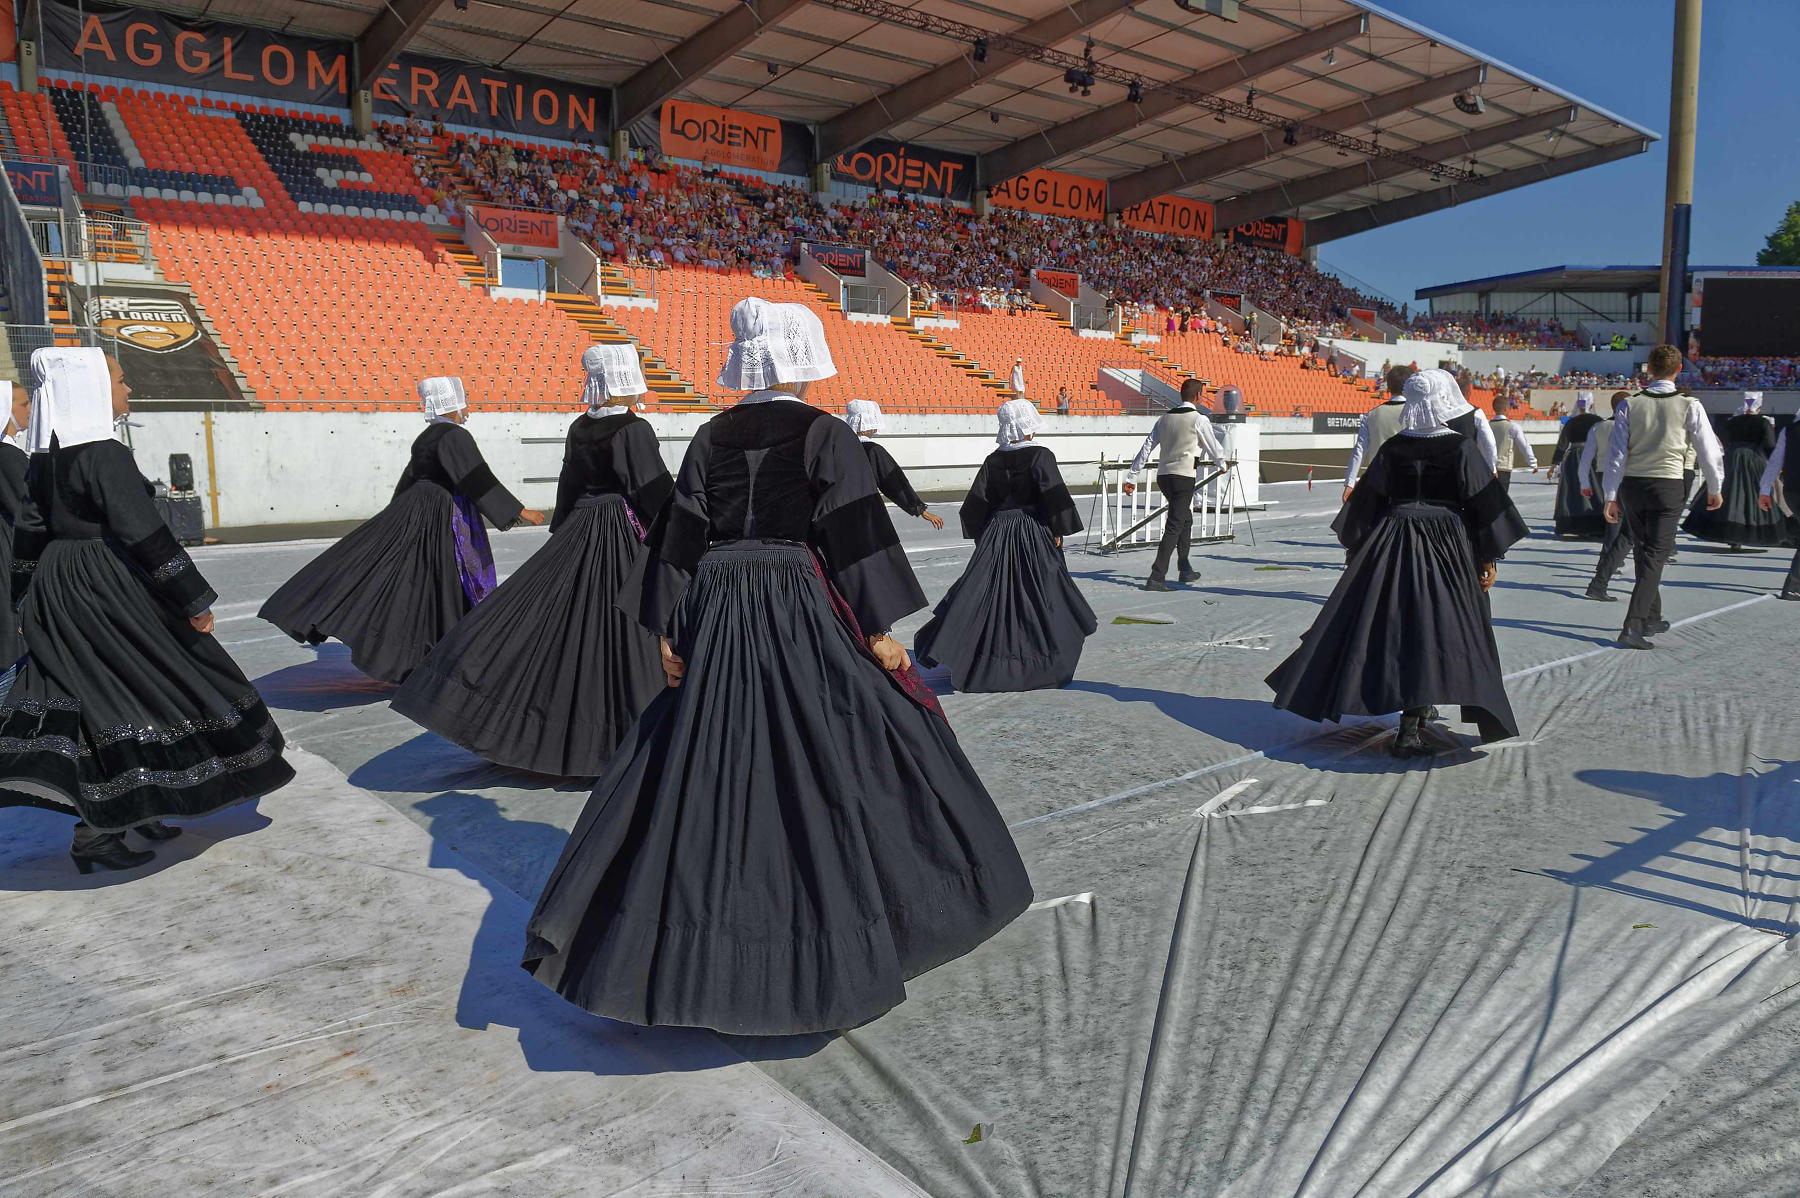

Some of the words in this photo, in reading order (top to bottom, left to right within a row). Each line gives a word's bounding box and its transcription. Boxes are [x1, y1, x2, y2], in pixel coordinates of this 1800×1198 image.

[670, 105, 775, 152] LORIENT
[837, 147, 963, 193] LORIENT
[475, 209, 554, 236] LORIENT
[120, 311, 191, 323] LORIENT
[1327, 417, 1361, 427] BRETAGNE
